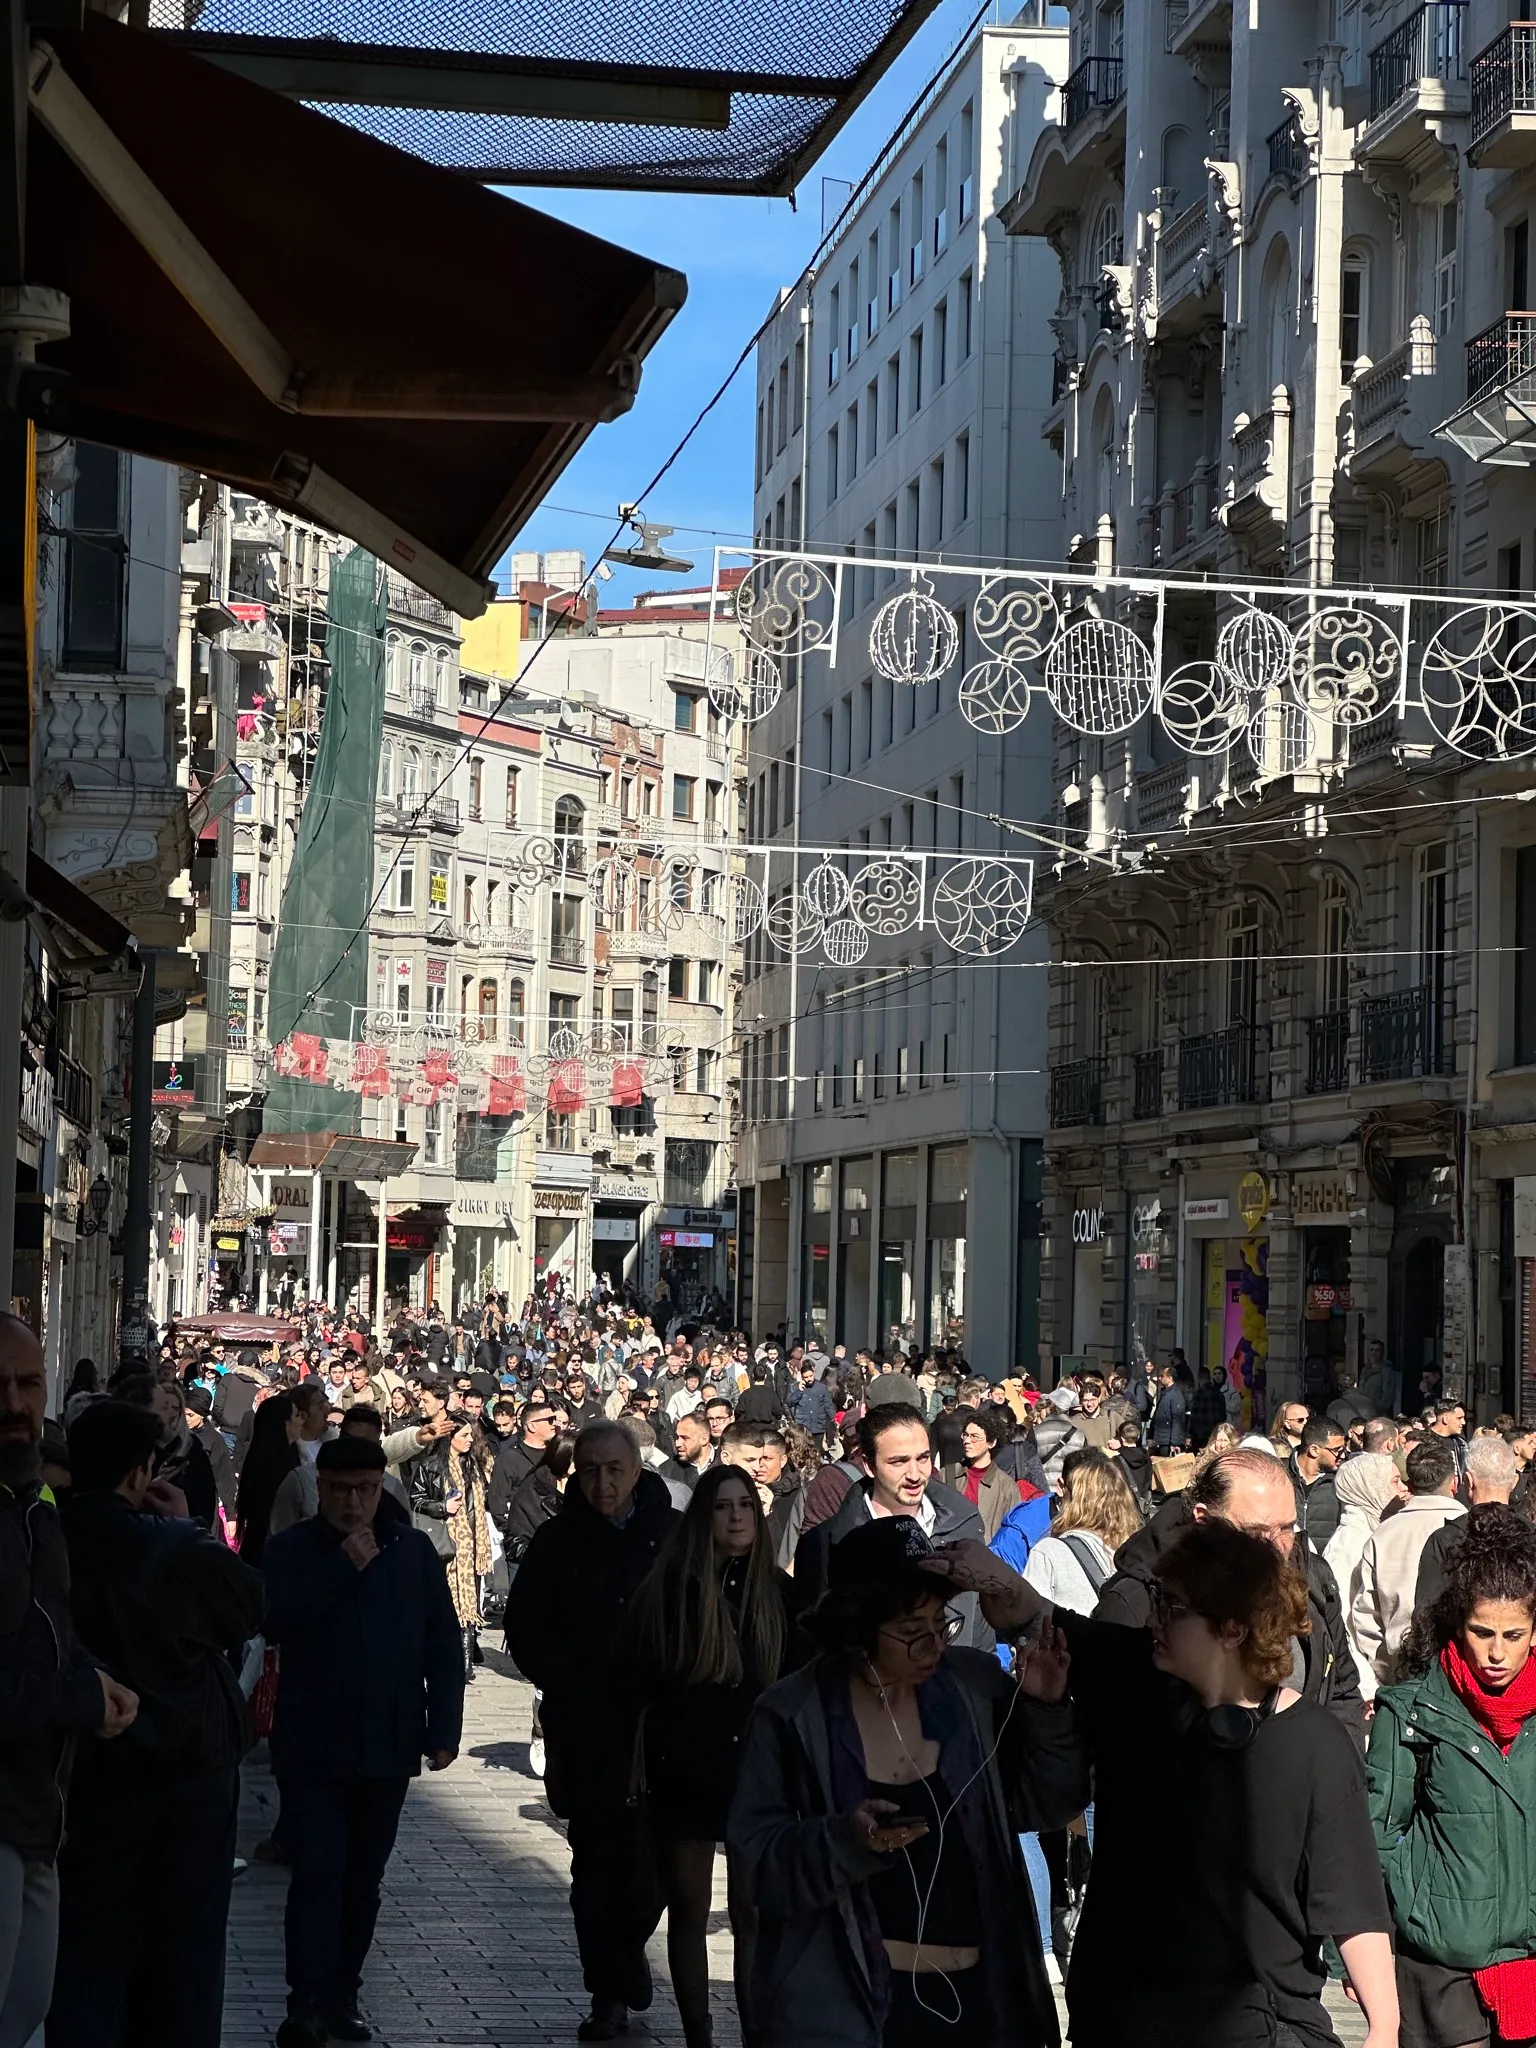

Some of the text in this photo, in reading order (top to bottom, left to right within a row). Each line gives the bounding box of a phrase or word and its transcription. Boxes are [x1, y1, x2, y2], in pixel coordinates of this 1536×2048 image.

[461, 1086, 478, 1094] CHP
[457, 1199, 489, 1215] JIMMY
[1314, 1289, 1335, 1303] %50
